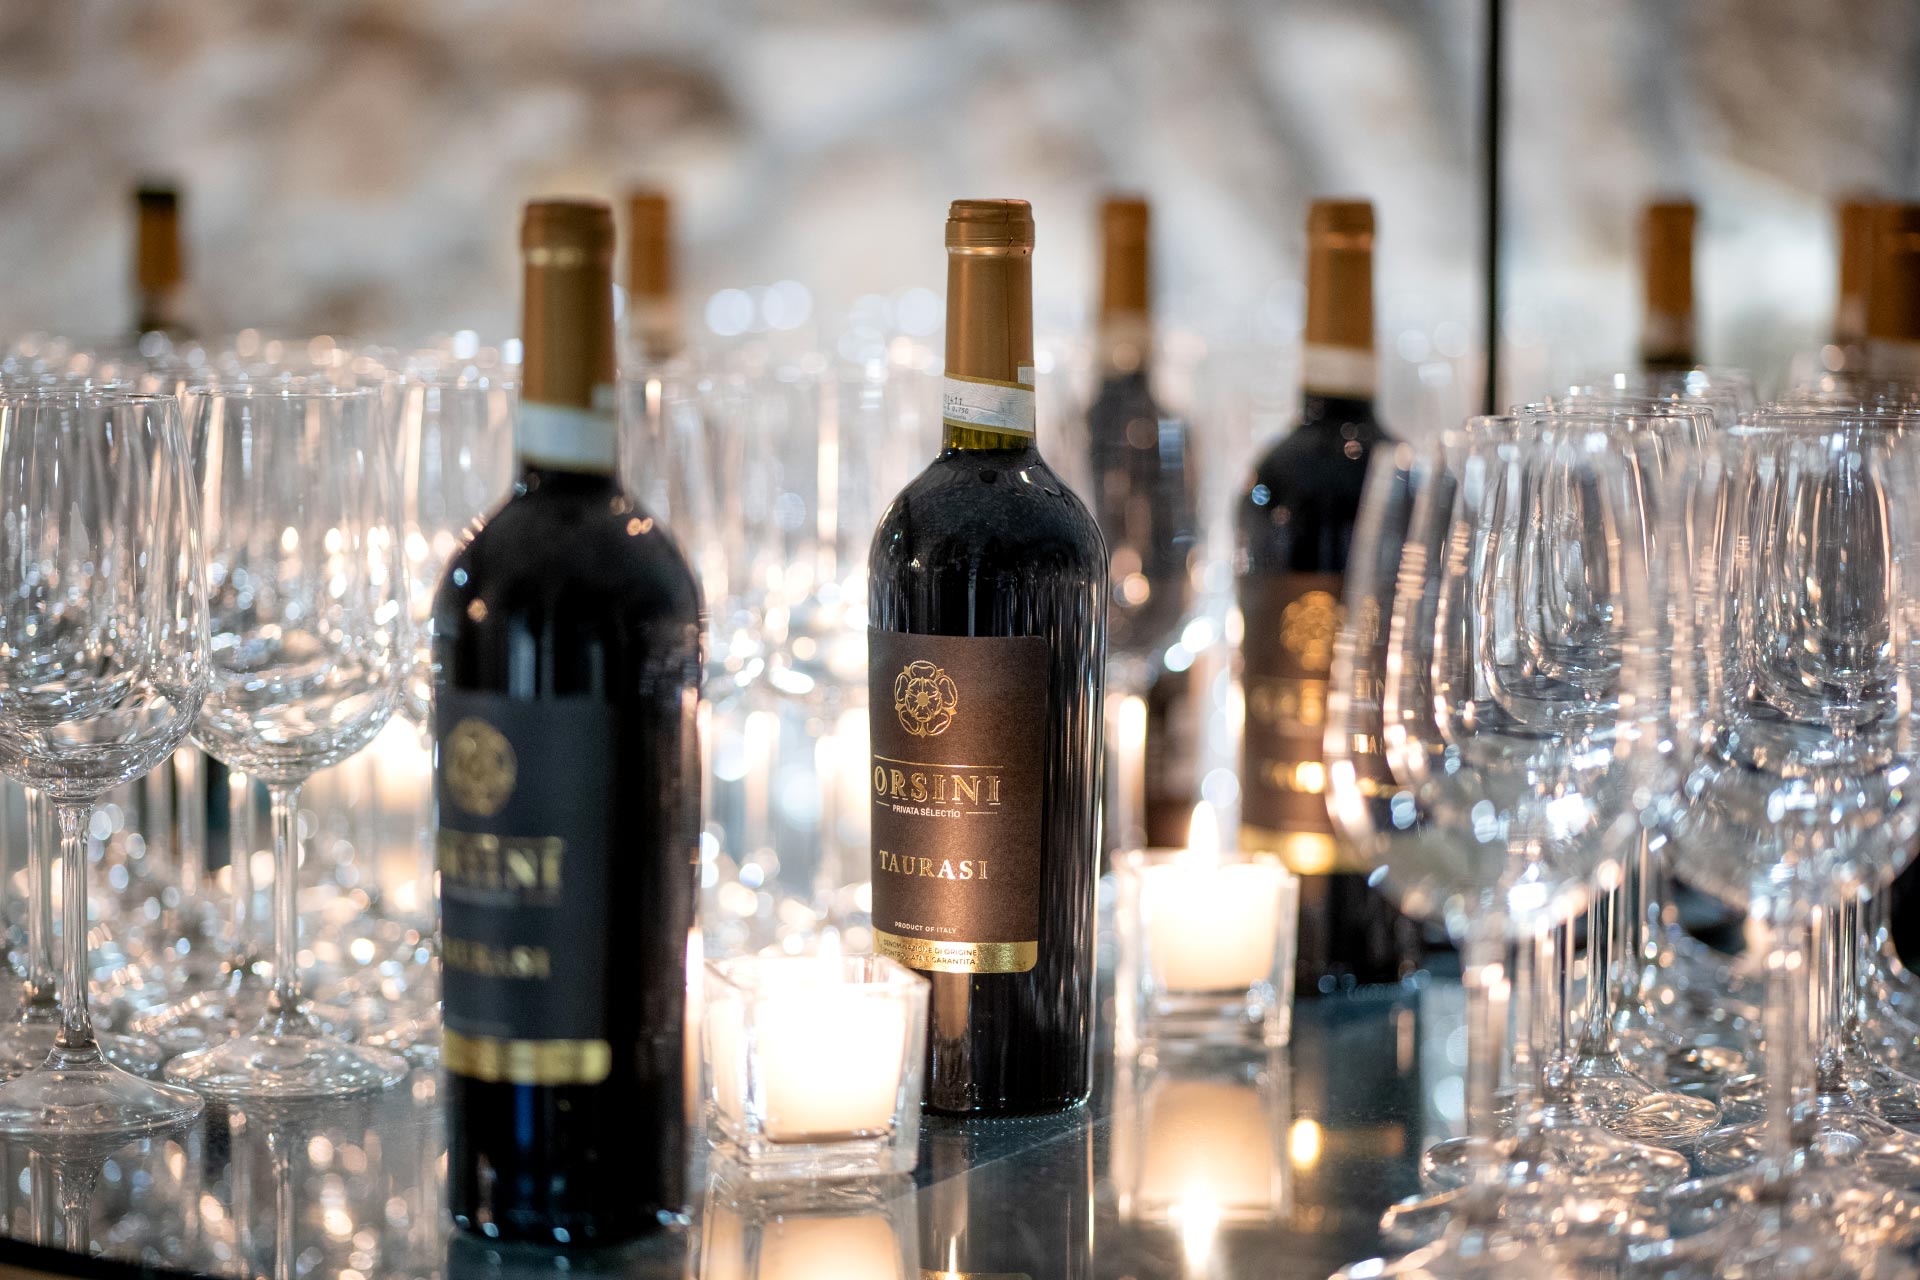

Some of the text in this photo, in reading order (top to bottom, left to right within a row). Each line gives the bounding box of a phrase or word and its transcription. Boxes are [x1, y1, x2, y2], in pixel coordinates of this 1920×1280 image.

[874, 765, 1001, 805] ORSINI
[892, 804, 920, 816] PRIVATA
[879, 850, 988, 880] TAURASI
[894, 921, 923, 932] PRODUCT
[934, 947, 943, 955] DI
[944, 948, 978, 956] ORIGINE
[931, 956, 976, 965] GARANTITA
